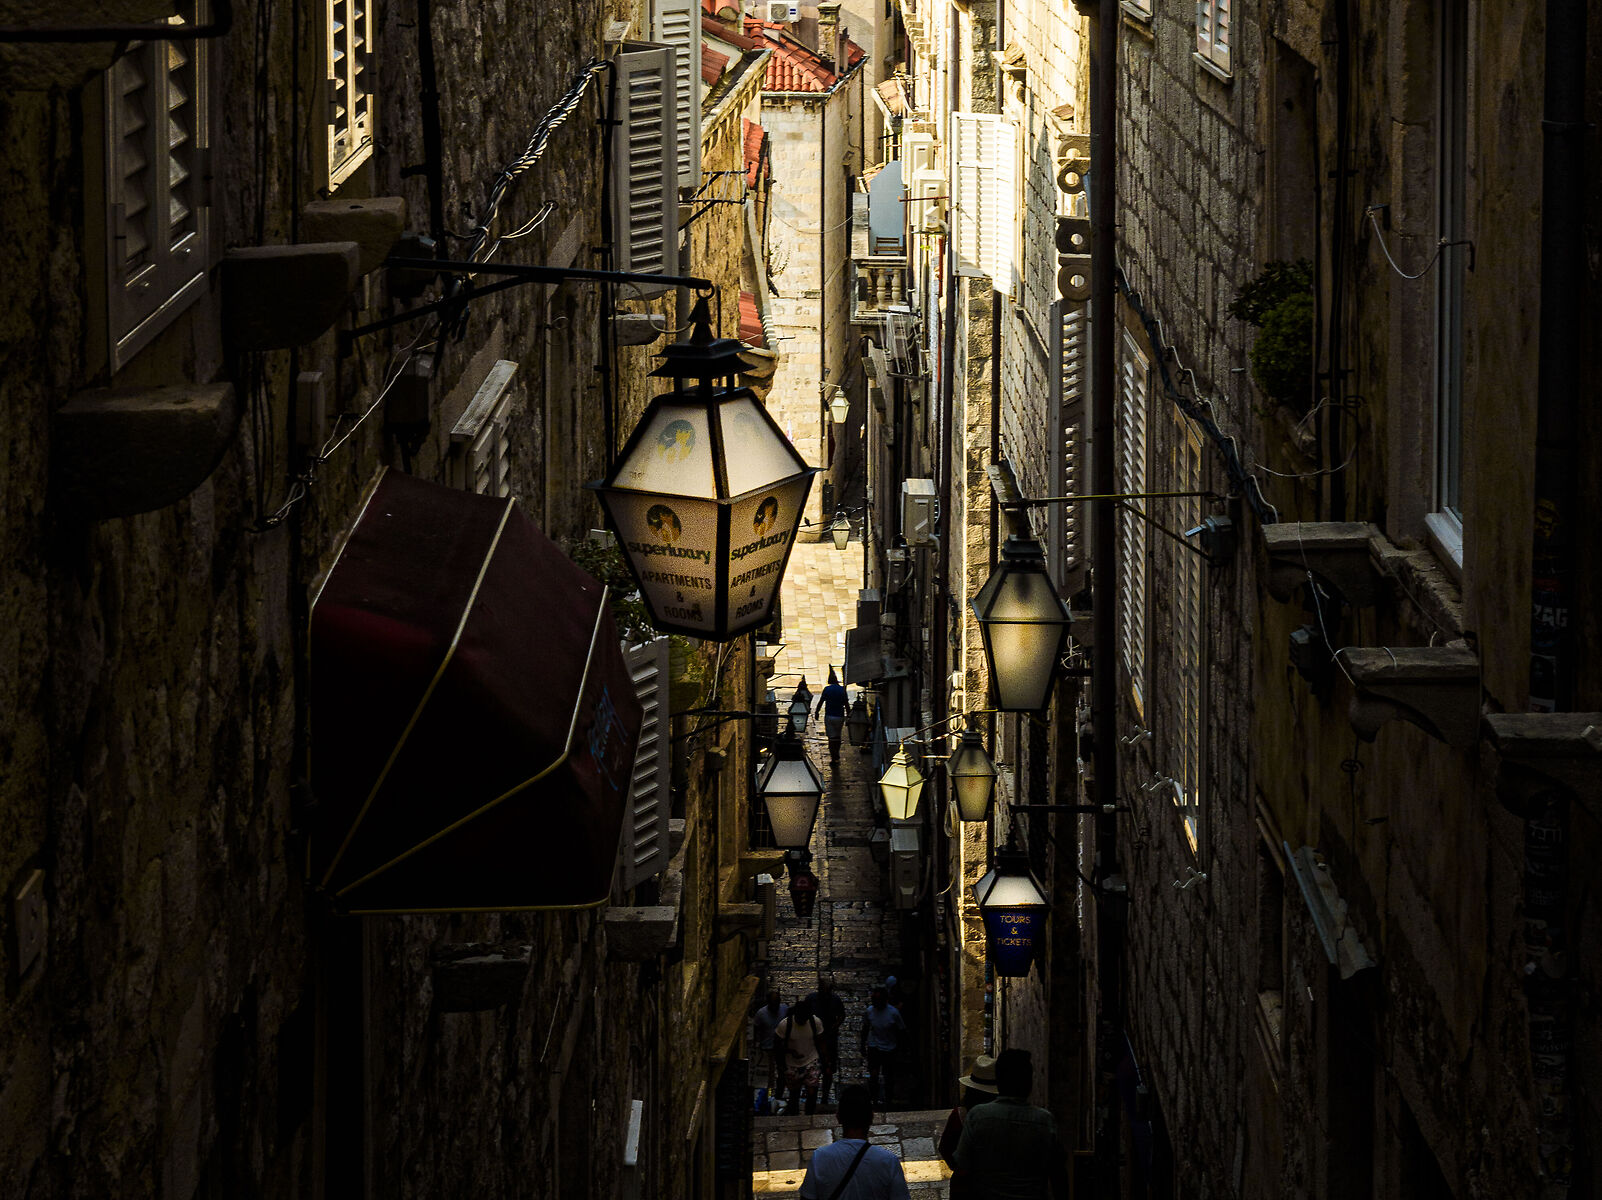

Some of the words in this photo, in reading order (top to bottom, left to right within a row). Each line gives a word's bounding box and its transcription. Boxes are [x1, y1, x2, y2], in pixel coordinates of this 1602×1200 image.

[641, 570, 713, 590] APARTMENTS
[731, 560, 782, 588] APARTMENTS
[676, 591, 684, 603] &
[749, 585, 756, 597] &
[664, 606, 704, 622] ROOMS
[736, 598, 764, 618] ROOMS
[1000, 915, 1031, 924] TOURS
[1010, 926, 1018, 935] &
[996, 937, 1032, 946] TICKETS
